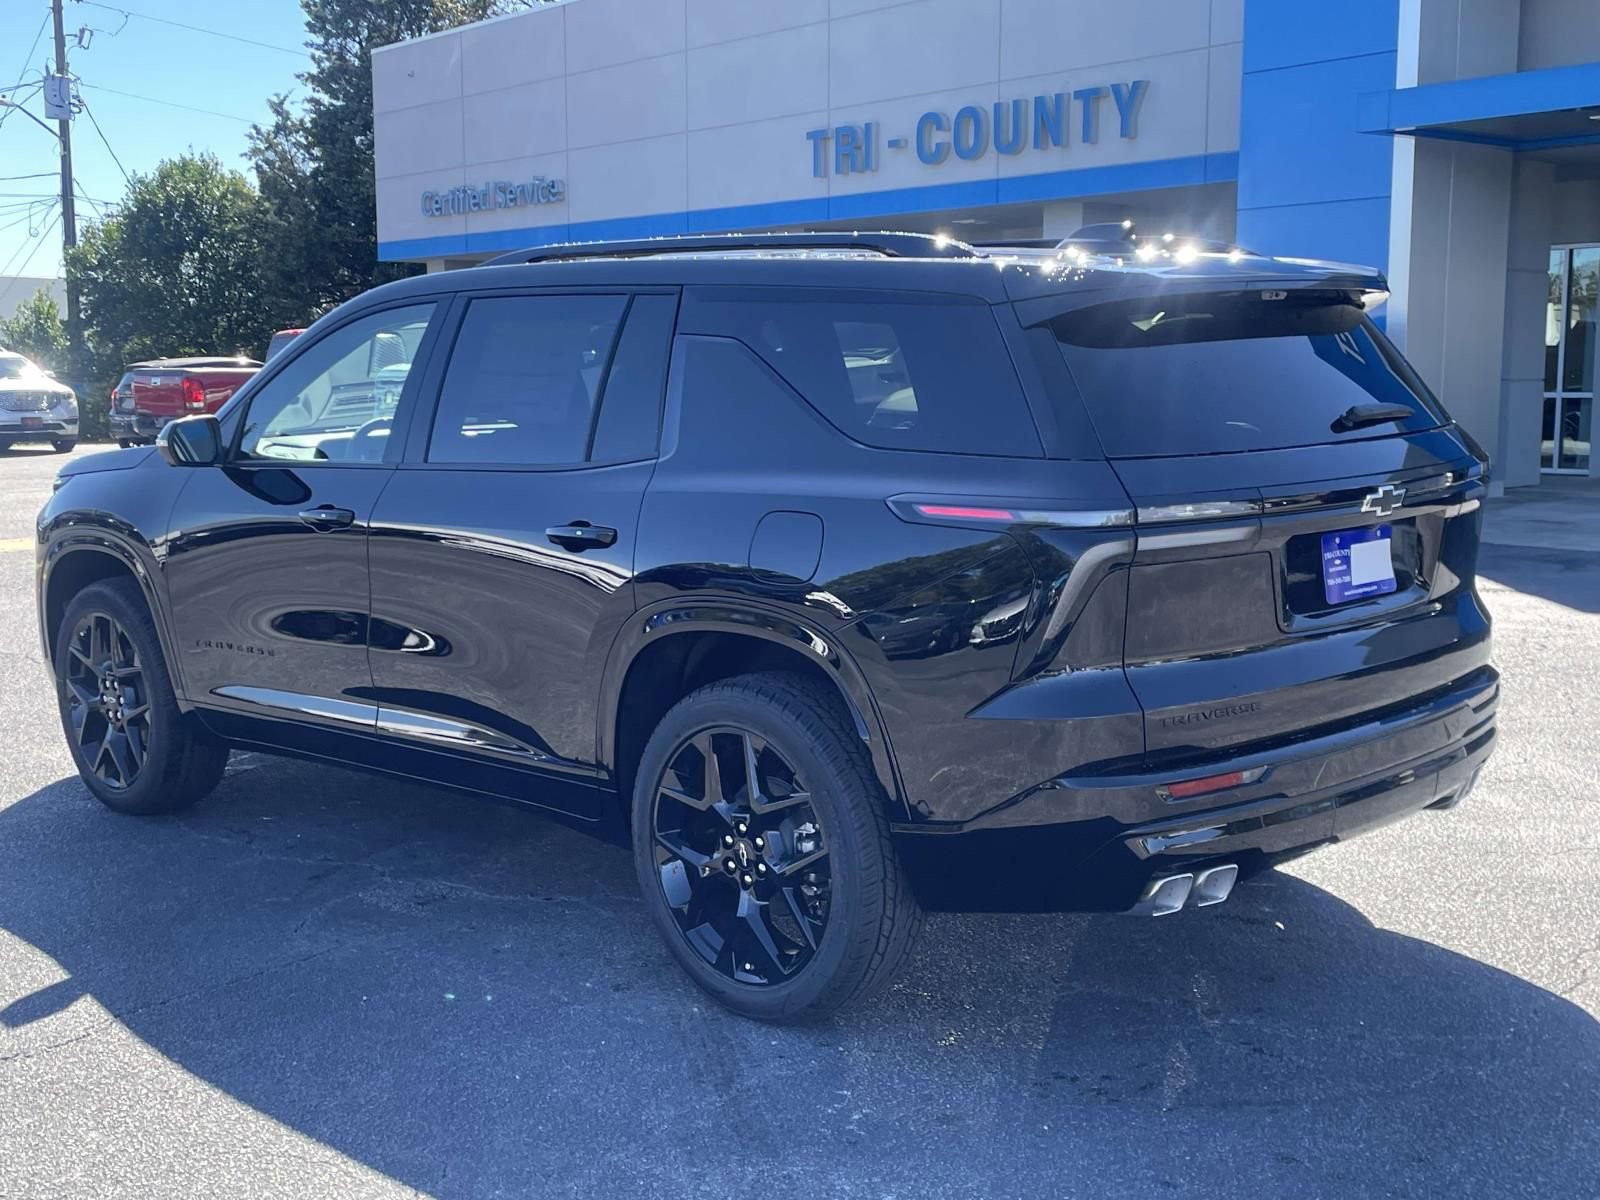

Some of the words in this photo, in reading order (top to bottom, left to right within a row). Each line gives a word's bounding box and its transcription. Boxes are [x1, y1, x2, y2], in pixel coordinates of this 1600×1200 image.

[806, 121, 879, 178] TRI
[916, 79, 1150, 166] COUNTY
[421, 182, 493, 217] Certified
[494, 176, 565, 210] Service
[1160, 702, 1262, 728] TRAVERSE
